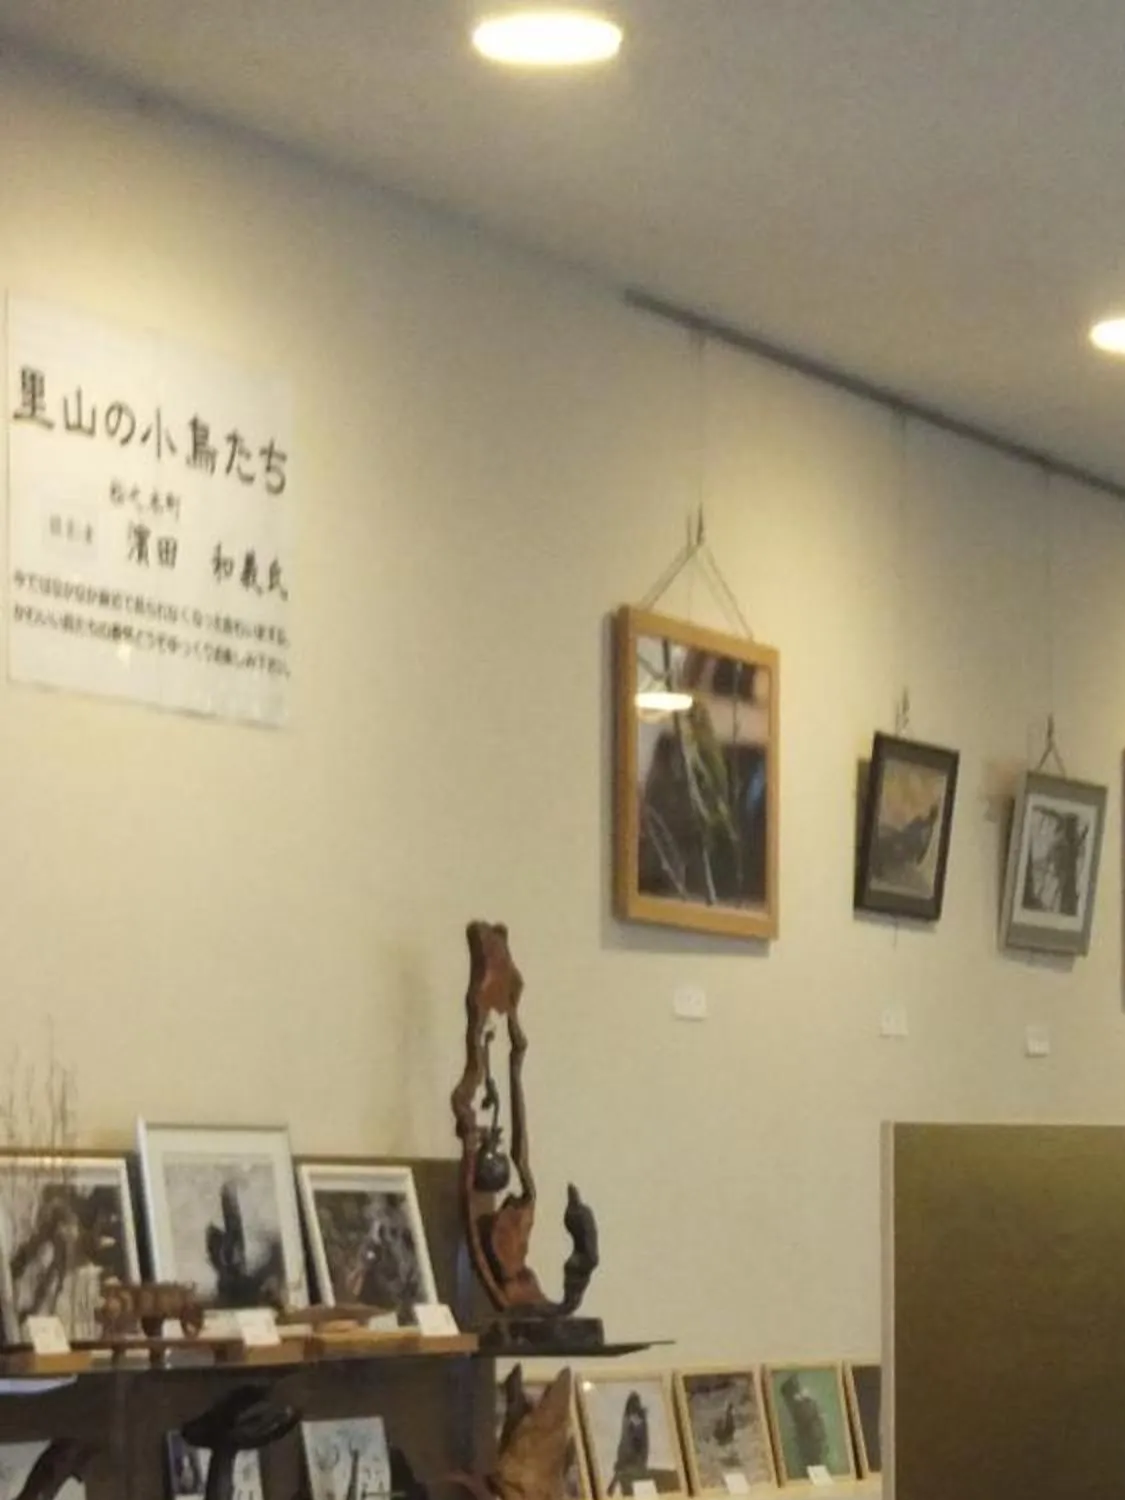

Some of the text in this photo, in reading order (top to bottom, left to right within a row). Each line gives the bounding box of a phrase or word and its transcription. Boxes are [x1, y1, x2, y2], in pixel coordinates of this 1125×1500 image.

[13, 364, 289, 497] 里山の小鳥たち
